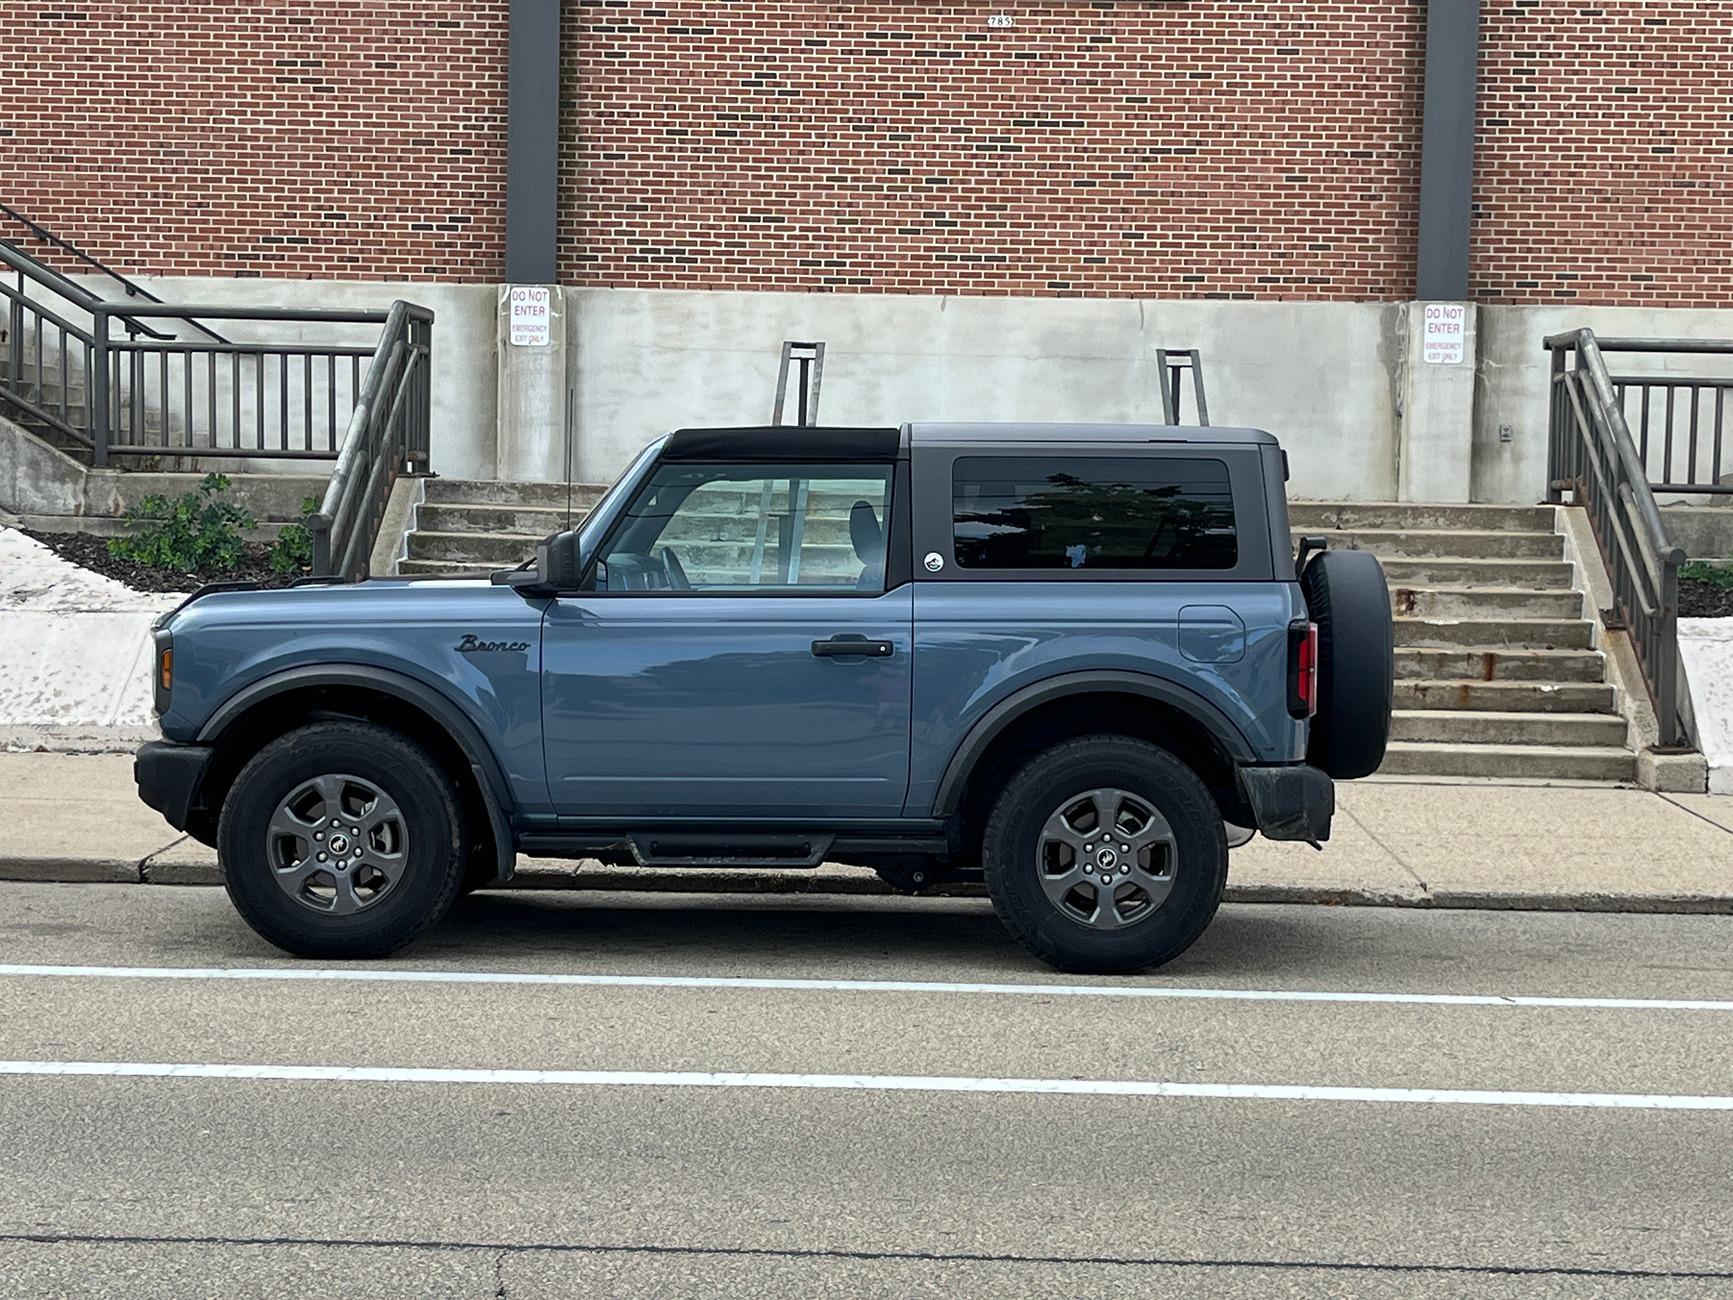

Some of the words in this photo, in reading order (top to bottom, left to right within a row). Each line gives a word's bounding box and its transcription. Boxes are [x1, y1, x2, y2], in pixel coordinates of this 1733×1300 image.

[991, 16, 1010, 25] 785
[512, 290, 526, 301] DO
[529, 290, 548, 301] NOT
[514, 305, 545, 316] ENTER
[1426, 308, 1441, 319] DO
[1443, 307, 1463, 319] NOT
[512, 324, 548, 332] EMERGENCY
[1428, 322, 1460, 334] ENTER
[1425, 342, 1461, 350] EMERGENCY
[454, 634, 531, 652] Bronco
